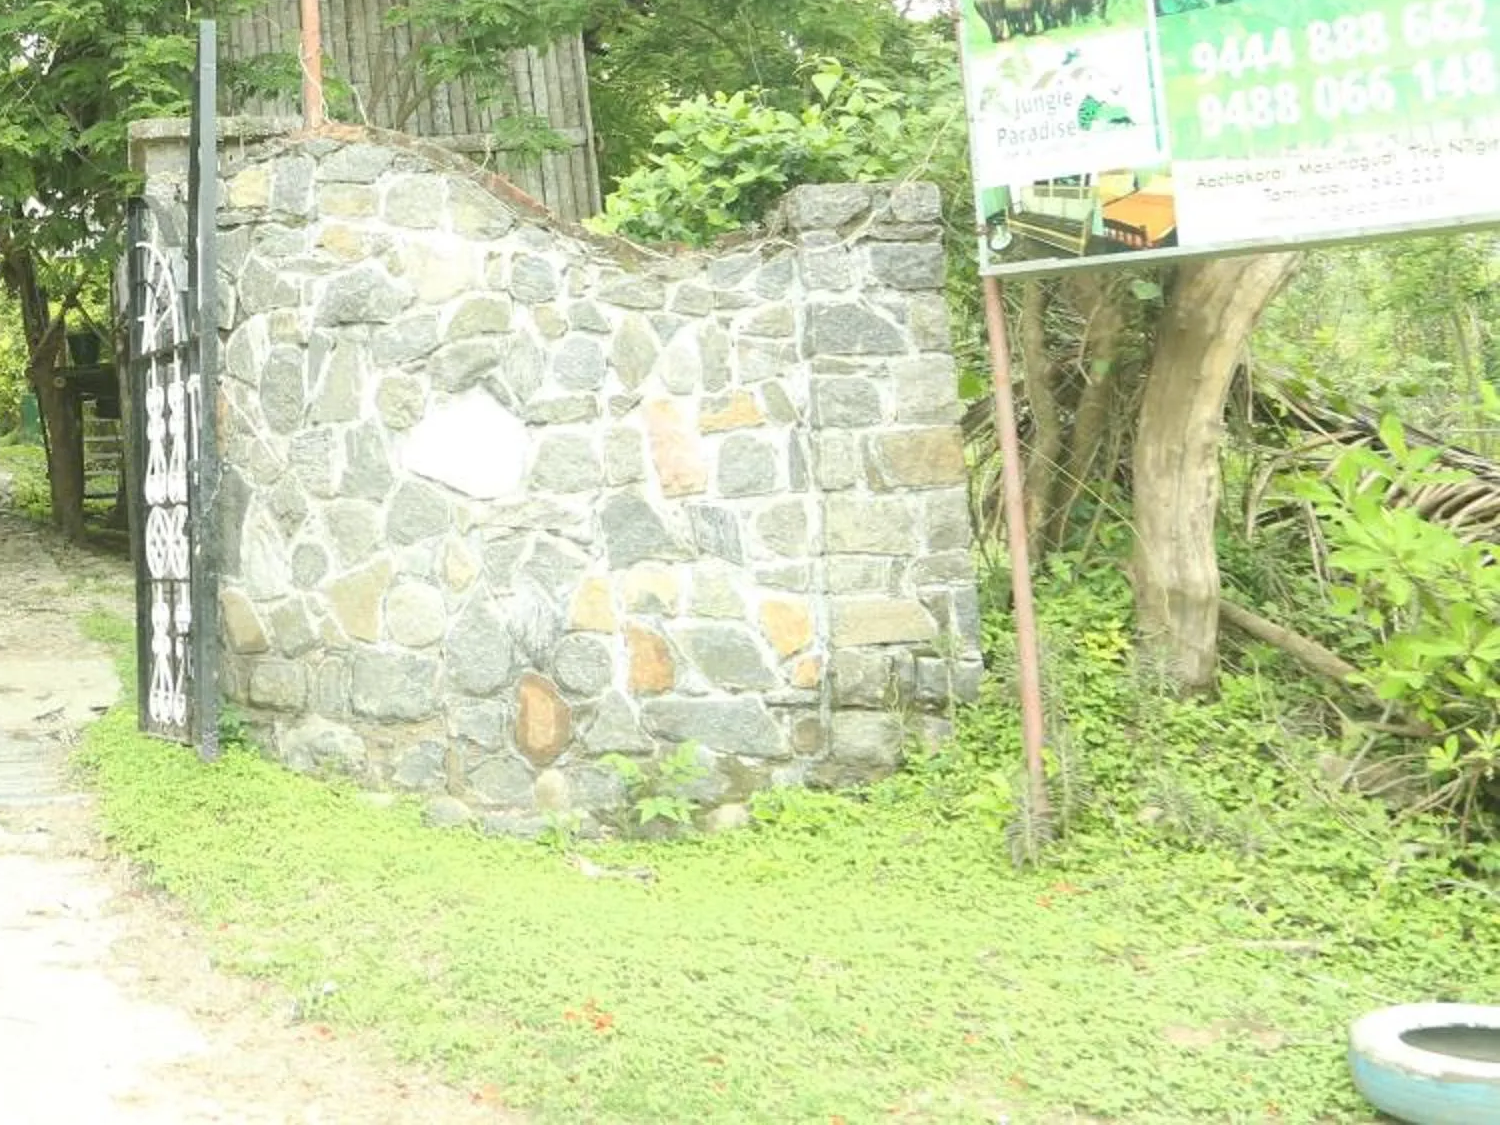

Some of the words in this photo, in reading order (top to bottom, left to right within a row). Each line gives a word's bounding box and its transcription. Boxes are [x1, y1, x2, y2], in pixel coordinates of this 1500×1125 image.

[1191, 26, 1294, 85] 9444
[1014, 89, 1074, 121] Jungle
[1197, 82, 1302, 138] 9488
[1314, 65, 1397, 119] 066
[1411, 49, 1497, 102] 148
[996, 119, 1078, 148] Paradise
